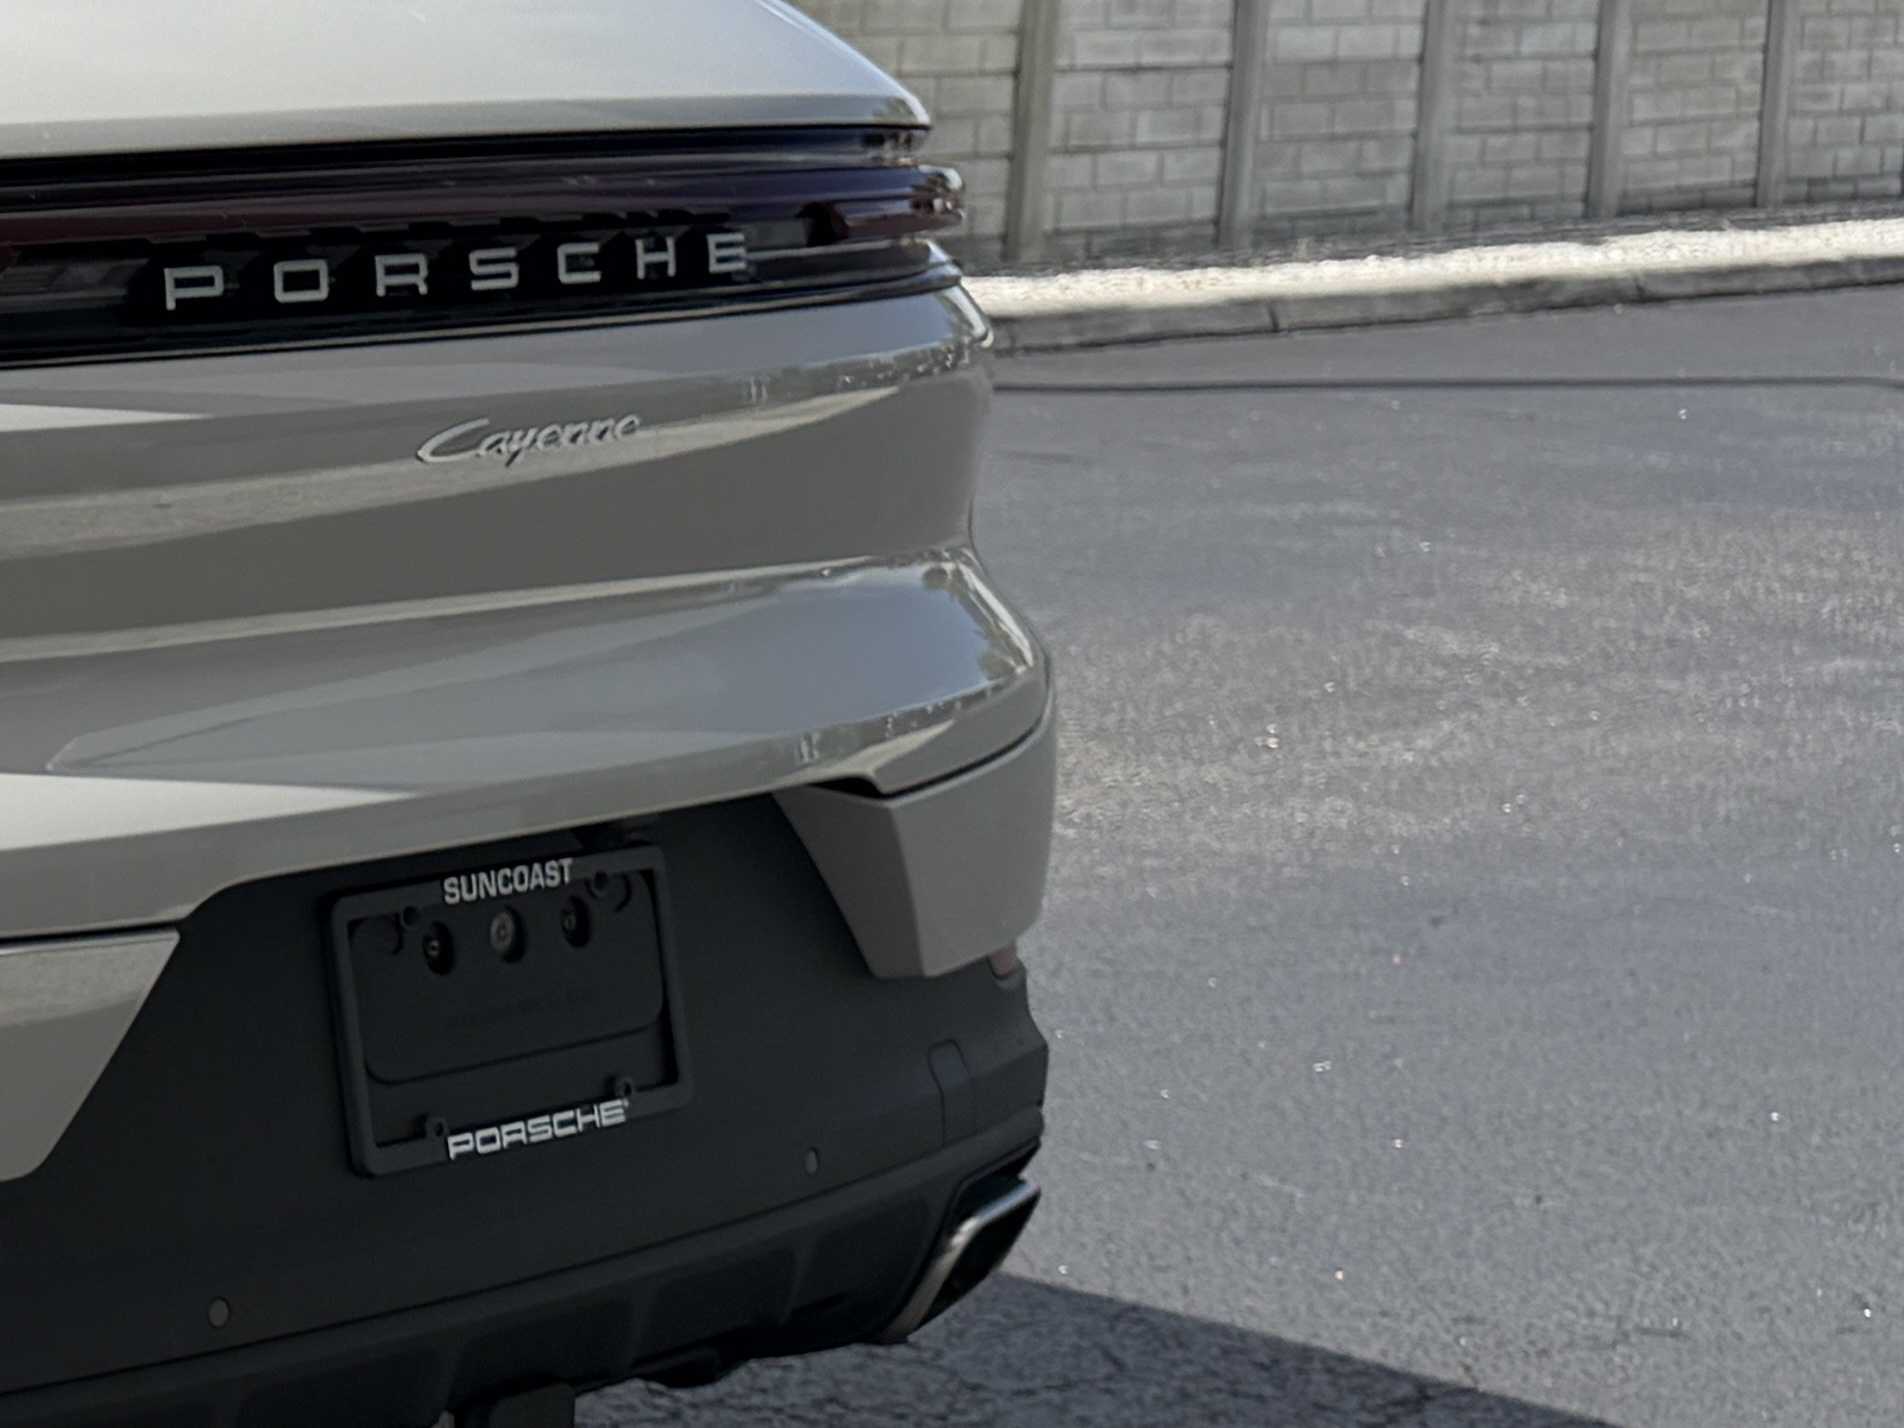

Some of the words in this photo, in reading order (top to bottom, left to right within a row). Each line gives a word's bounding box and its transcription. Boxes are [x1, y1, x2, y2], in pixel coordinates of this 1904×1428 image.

[165, 232, 748, 312] PORSCHE
[416, 413, 641, 468] Cayenne
[443, 858, 574, 905] SUNCOAST
[447, 1099, 627, 1160] PORSCHE
